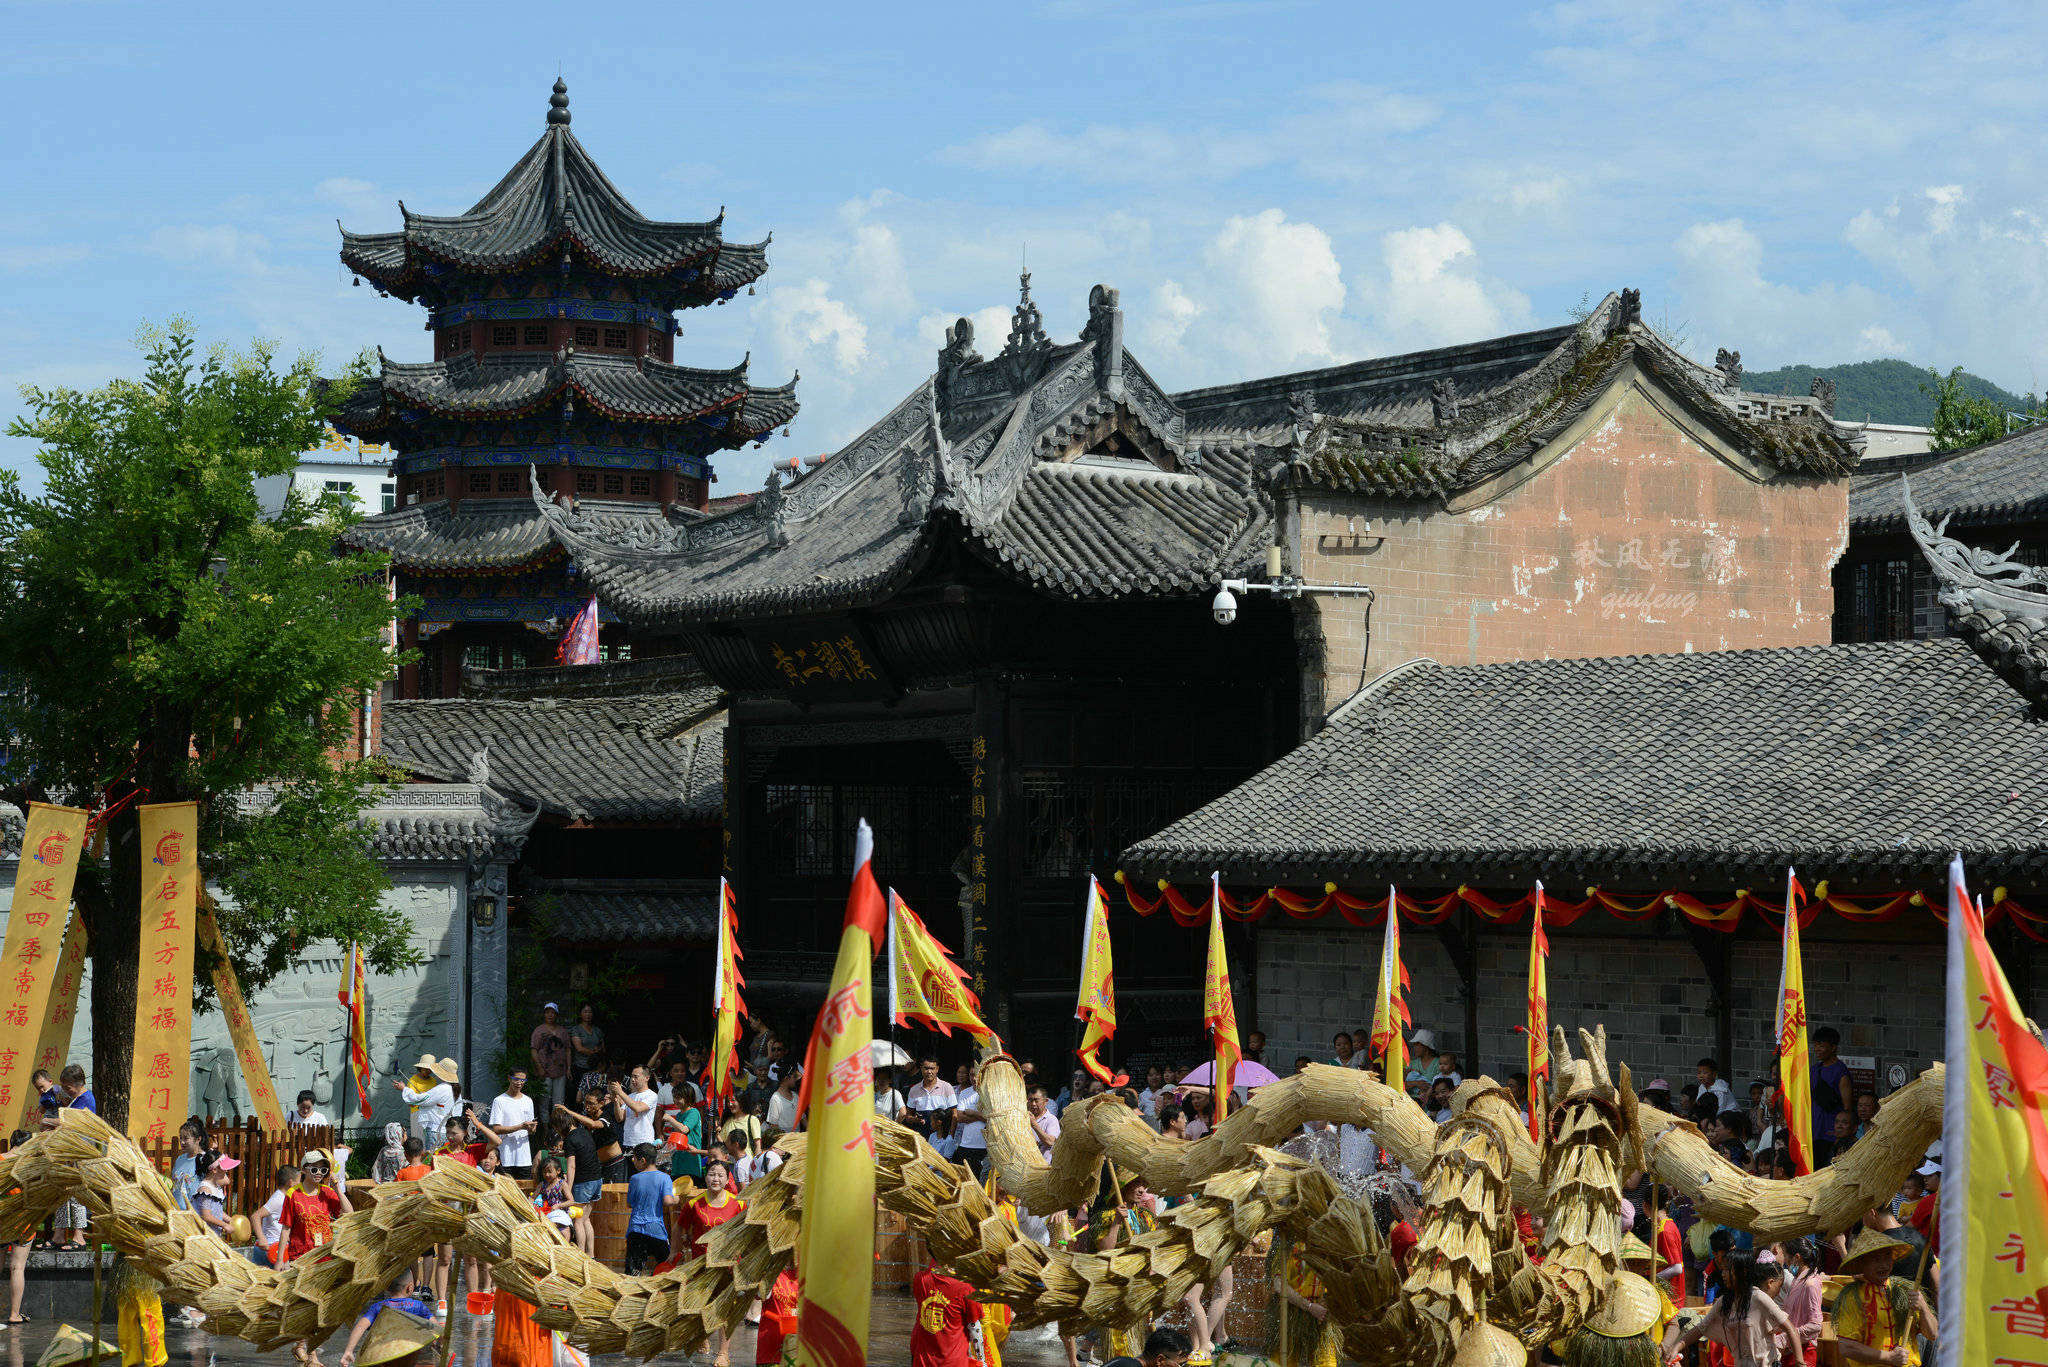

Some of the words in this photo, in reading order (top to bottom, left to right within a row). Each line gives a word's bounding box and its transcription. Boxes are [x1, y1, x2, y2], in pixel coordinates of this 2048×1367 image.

[4, 877, 56, 1027] 延四季常福
[151, 875, 181, 1031] 启五方瑞福
